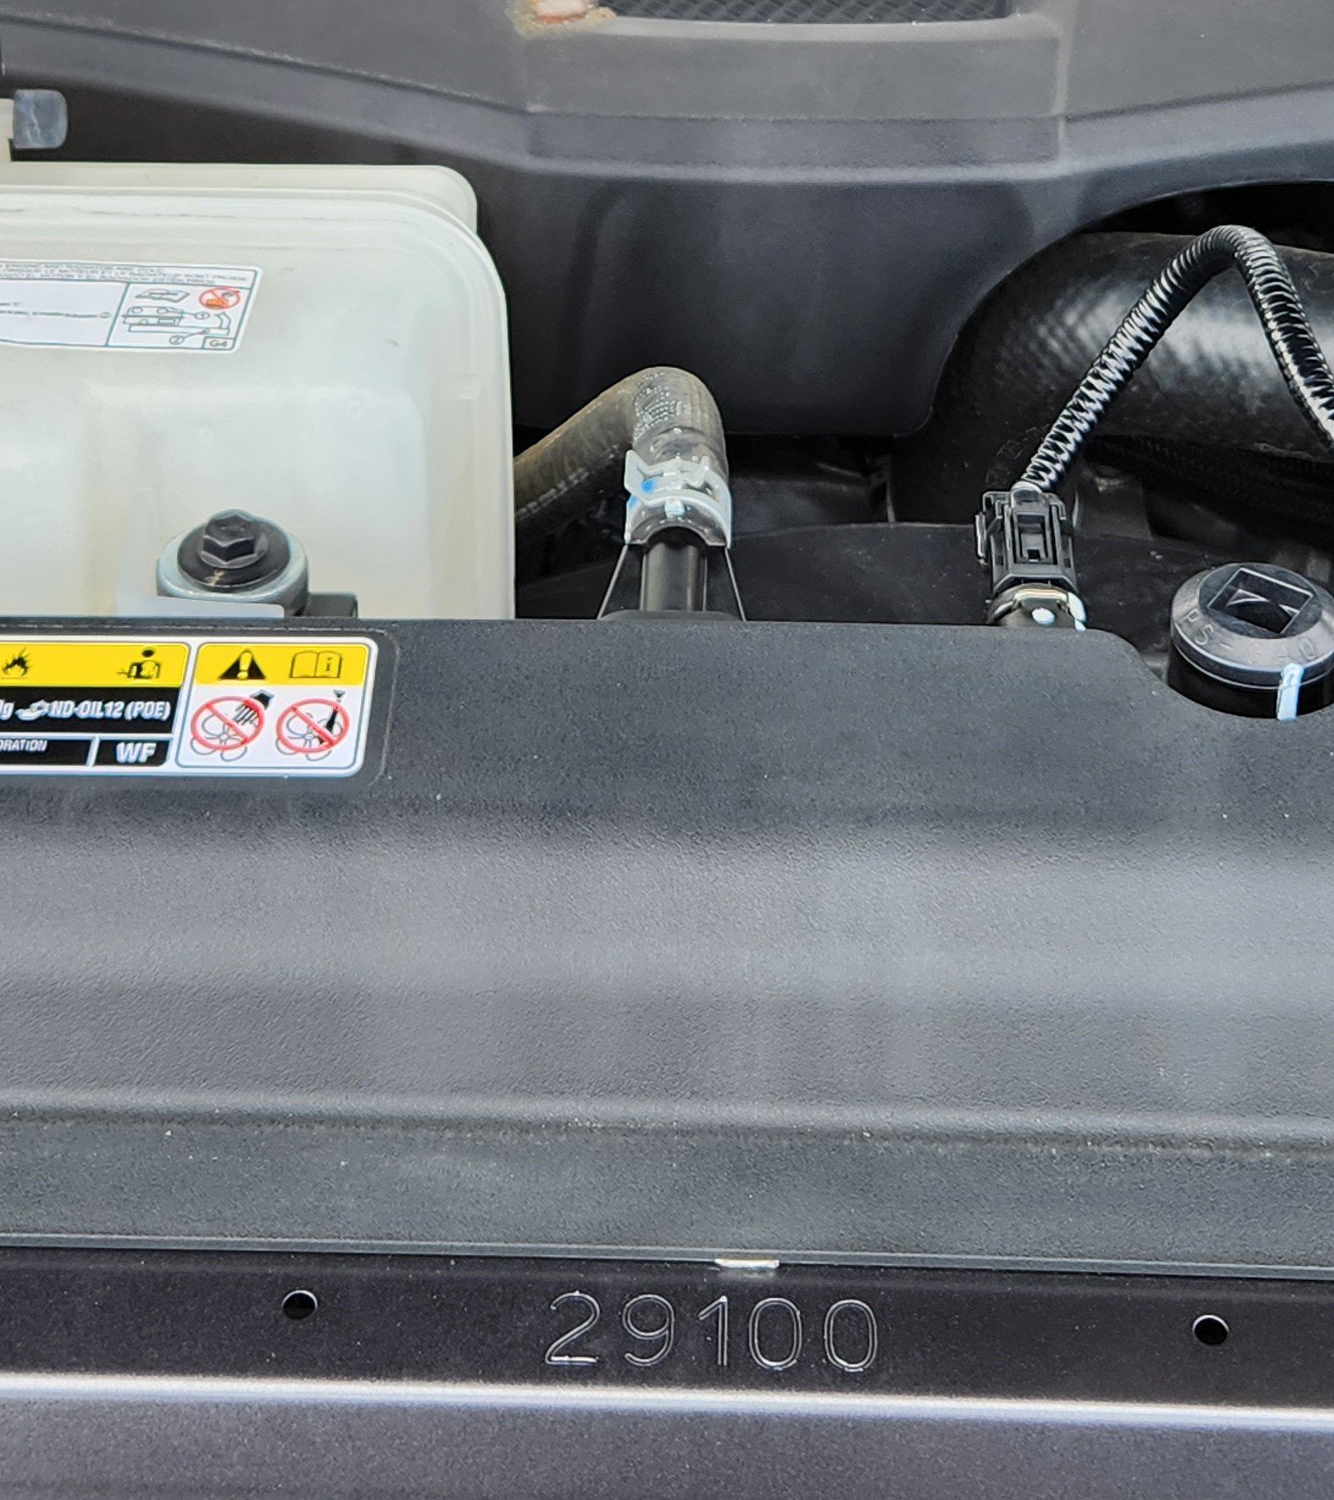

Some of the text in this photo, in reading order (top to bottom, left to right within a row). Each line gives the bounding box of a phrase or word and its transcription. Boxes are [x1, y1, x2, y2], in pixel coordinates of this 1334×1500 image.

[209, 339, 228, 347] G4
[124, 701, 171, 721] (POE)
[116, 741, 157, 763] WF
[545, 1290, 878, 1373] 29100
